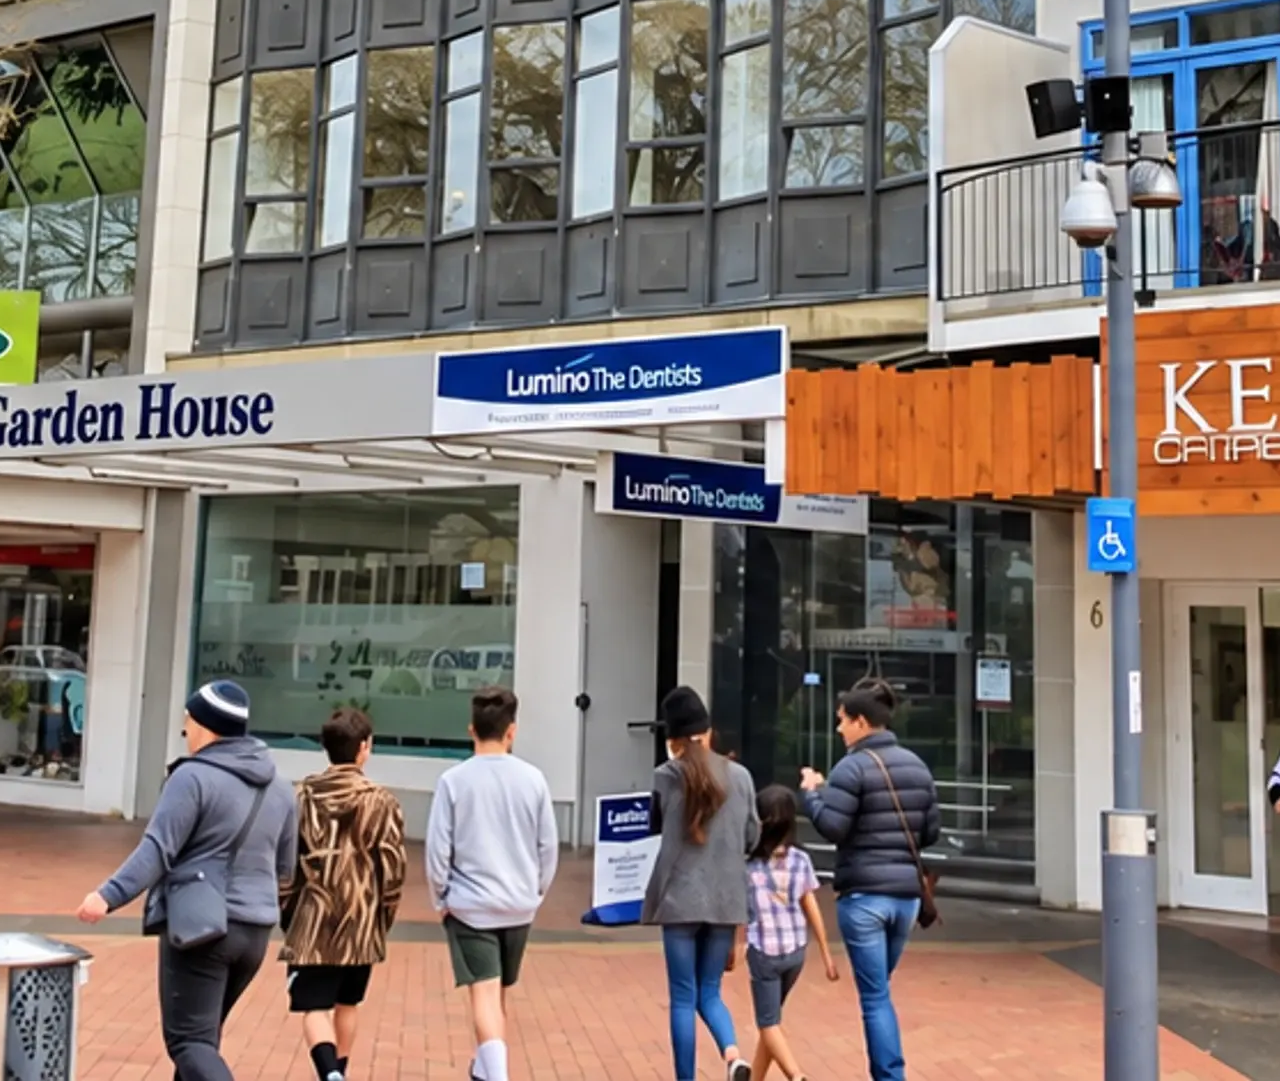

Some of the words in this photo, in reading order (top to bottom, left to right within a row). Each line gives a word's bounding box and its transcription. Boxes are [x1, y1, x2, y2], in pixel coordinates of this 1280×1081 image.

[507, 367, 590, 397] Lumino
[592, 367, 625, 391] The
[629, 363, 702, 389] Dentists
[135, 383, 274, 439] House
[625, 475, 690, 505] Lumino
[1090, 600, 1104, 629] 6
